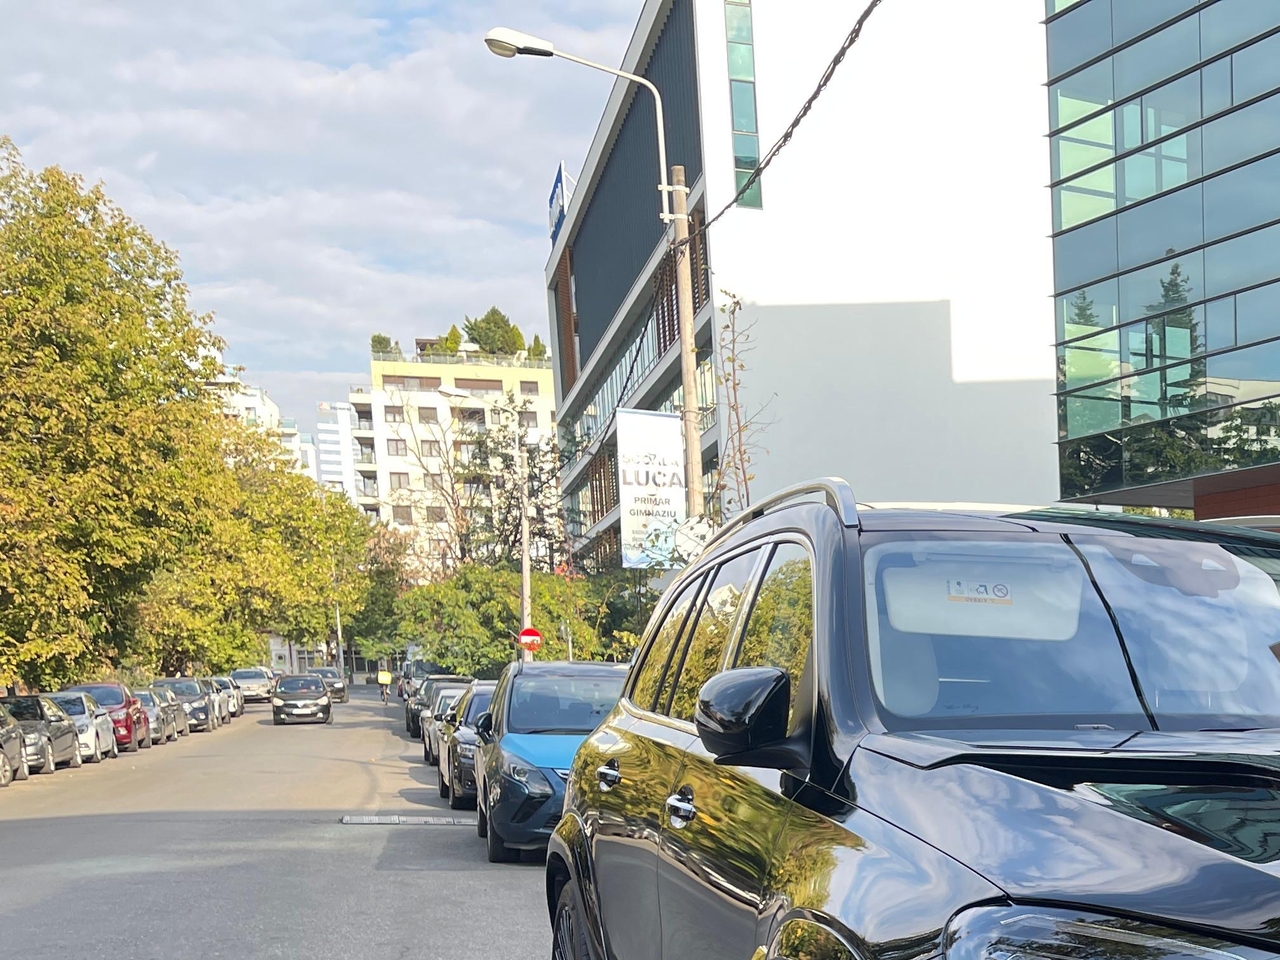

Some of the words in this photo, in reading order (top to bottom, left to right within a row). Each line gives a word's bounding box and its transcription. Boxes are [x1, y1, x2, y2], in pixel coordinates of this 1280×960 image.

[622, 469, 684, 488] LUCA
[634, 497, 671, 506] PRIMAR
[629, 509, 677, 518] GIMNAZIU
